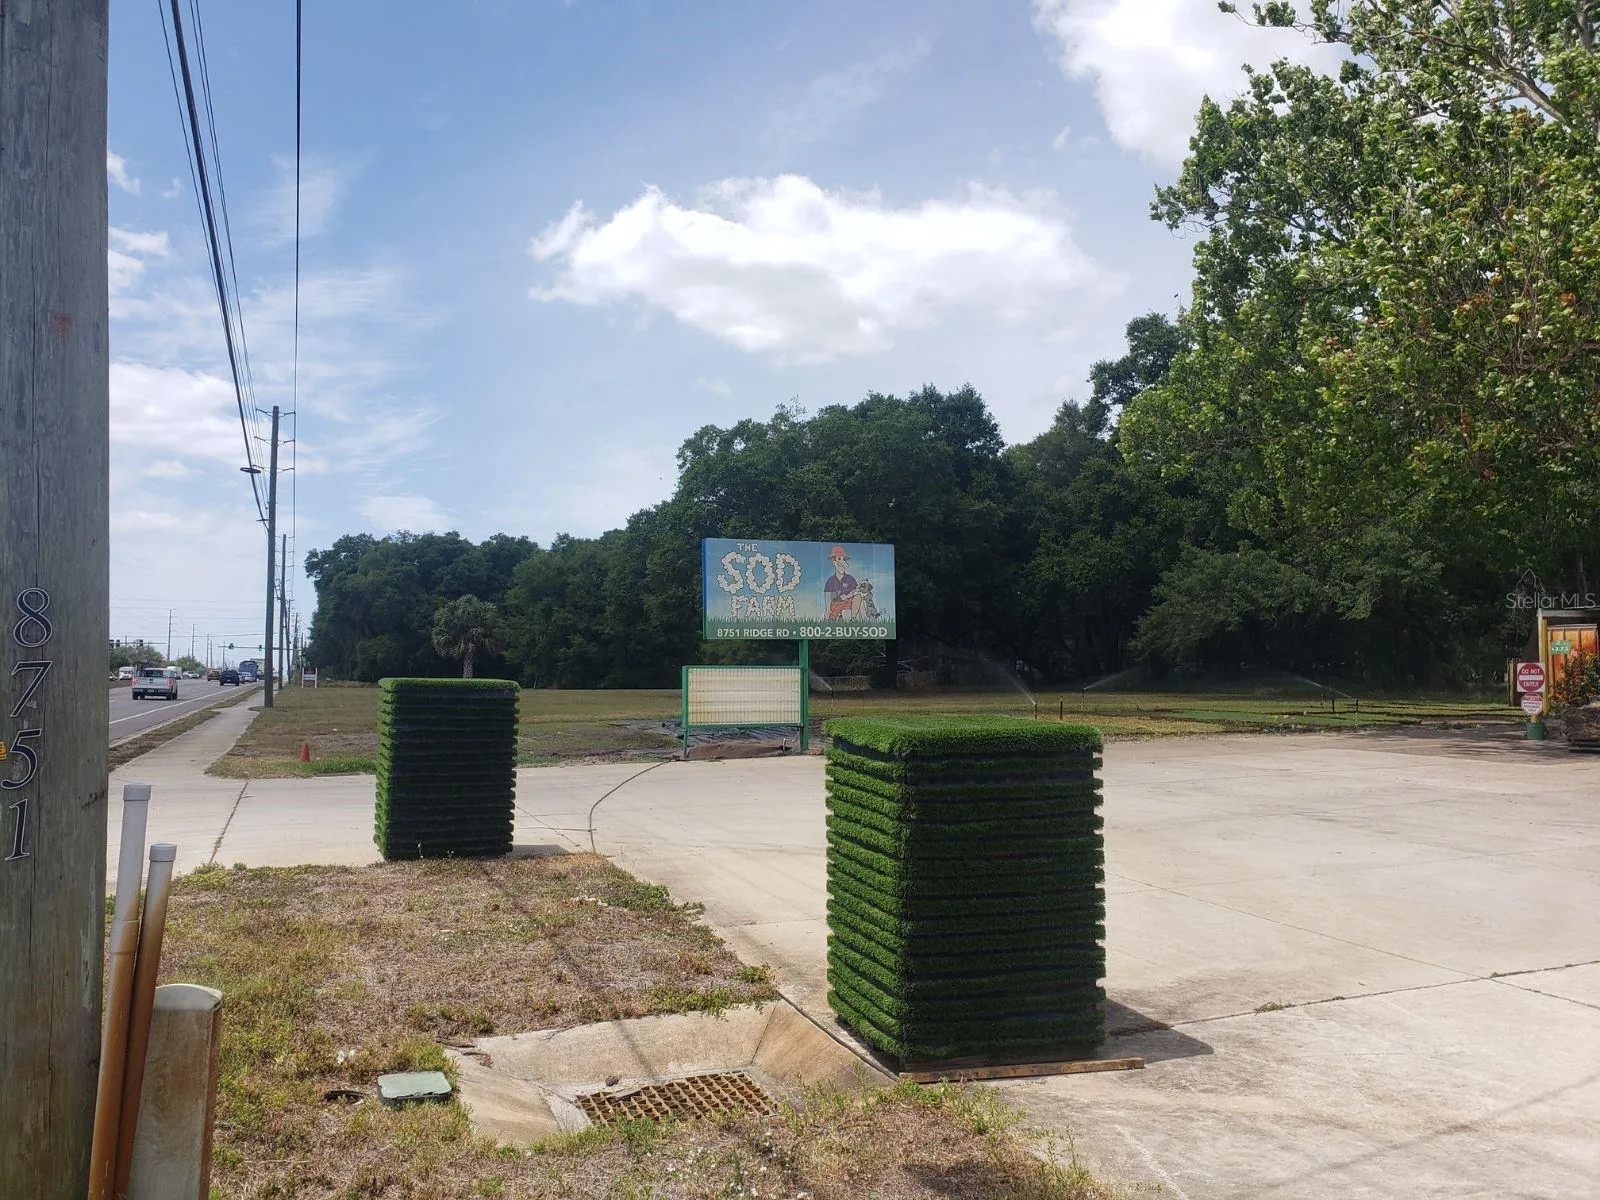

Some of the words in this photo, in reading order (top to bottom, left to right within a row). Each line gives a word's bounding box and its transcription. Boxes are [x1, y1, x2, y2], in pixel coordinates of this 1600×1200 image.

[737, 542, 759, 552] THE
[716, 551, 802, 594] SOD
[731, 595, 796, 618] FARM
[717, 628, 741, 638] 8751
[743, 628, 773, 638] RIDGE
[776, 628, 790, 638] RD
[800, 626, 888, 638] 800-2-BUY-SOD
[0, 587, 53, 862] 8751
